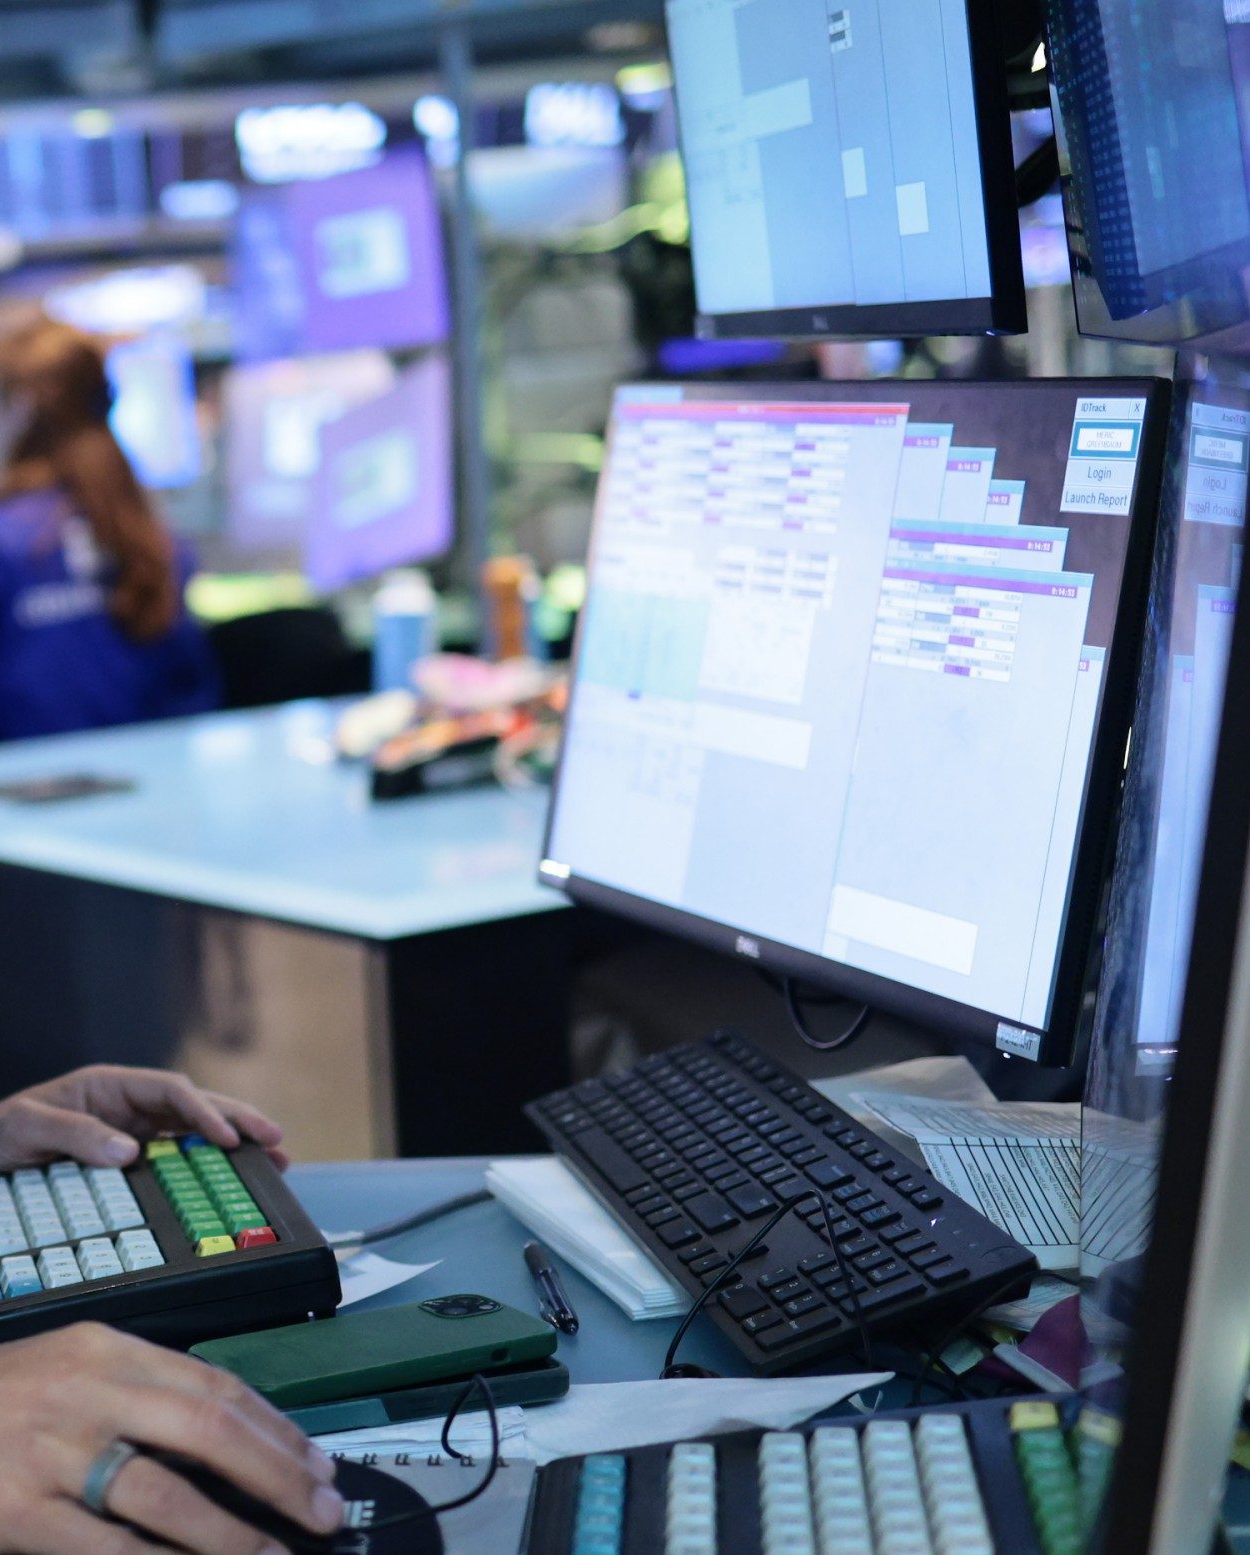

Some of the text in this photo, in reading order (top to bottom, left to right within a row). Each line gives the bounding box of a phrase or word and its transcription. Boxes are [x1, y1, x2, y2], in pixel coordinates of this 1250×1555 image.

[1081, 403, 1107, 413] IDTrack
[1087, 466, 1112, 481] Login
[1064, 491, 1128, 508] Launch Report
